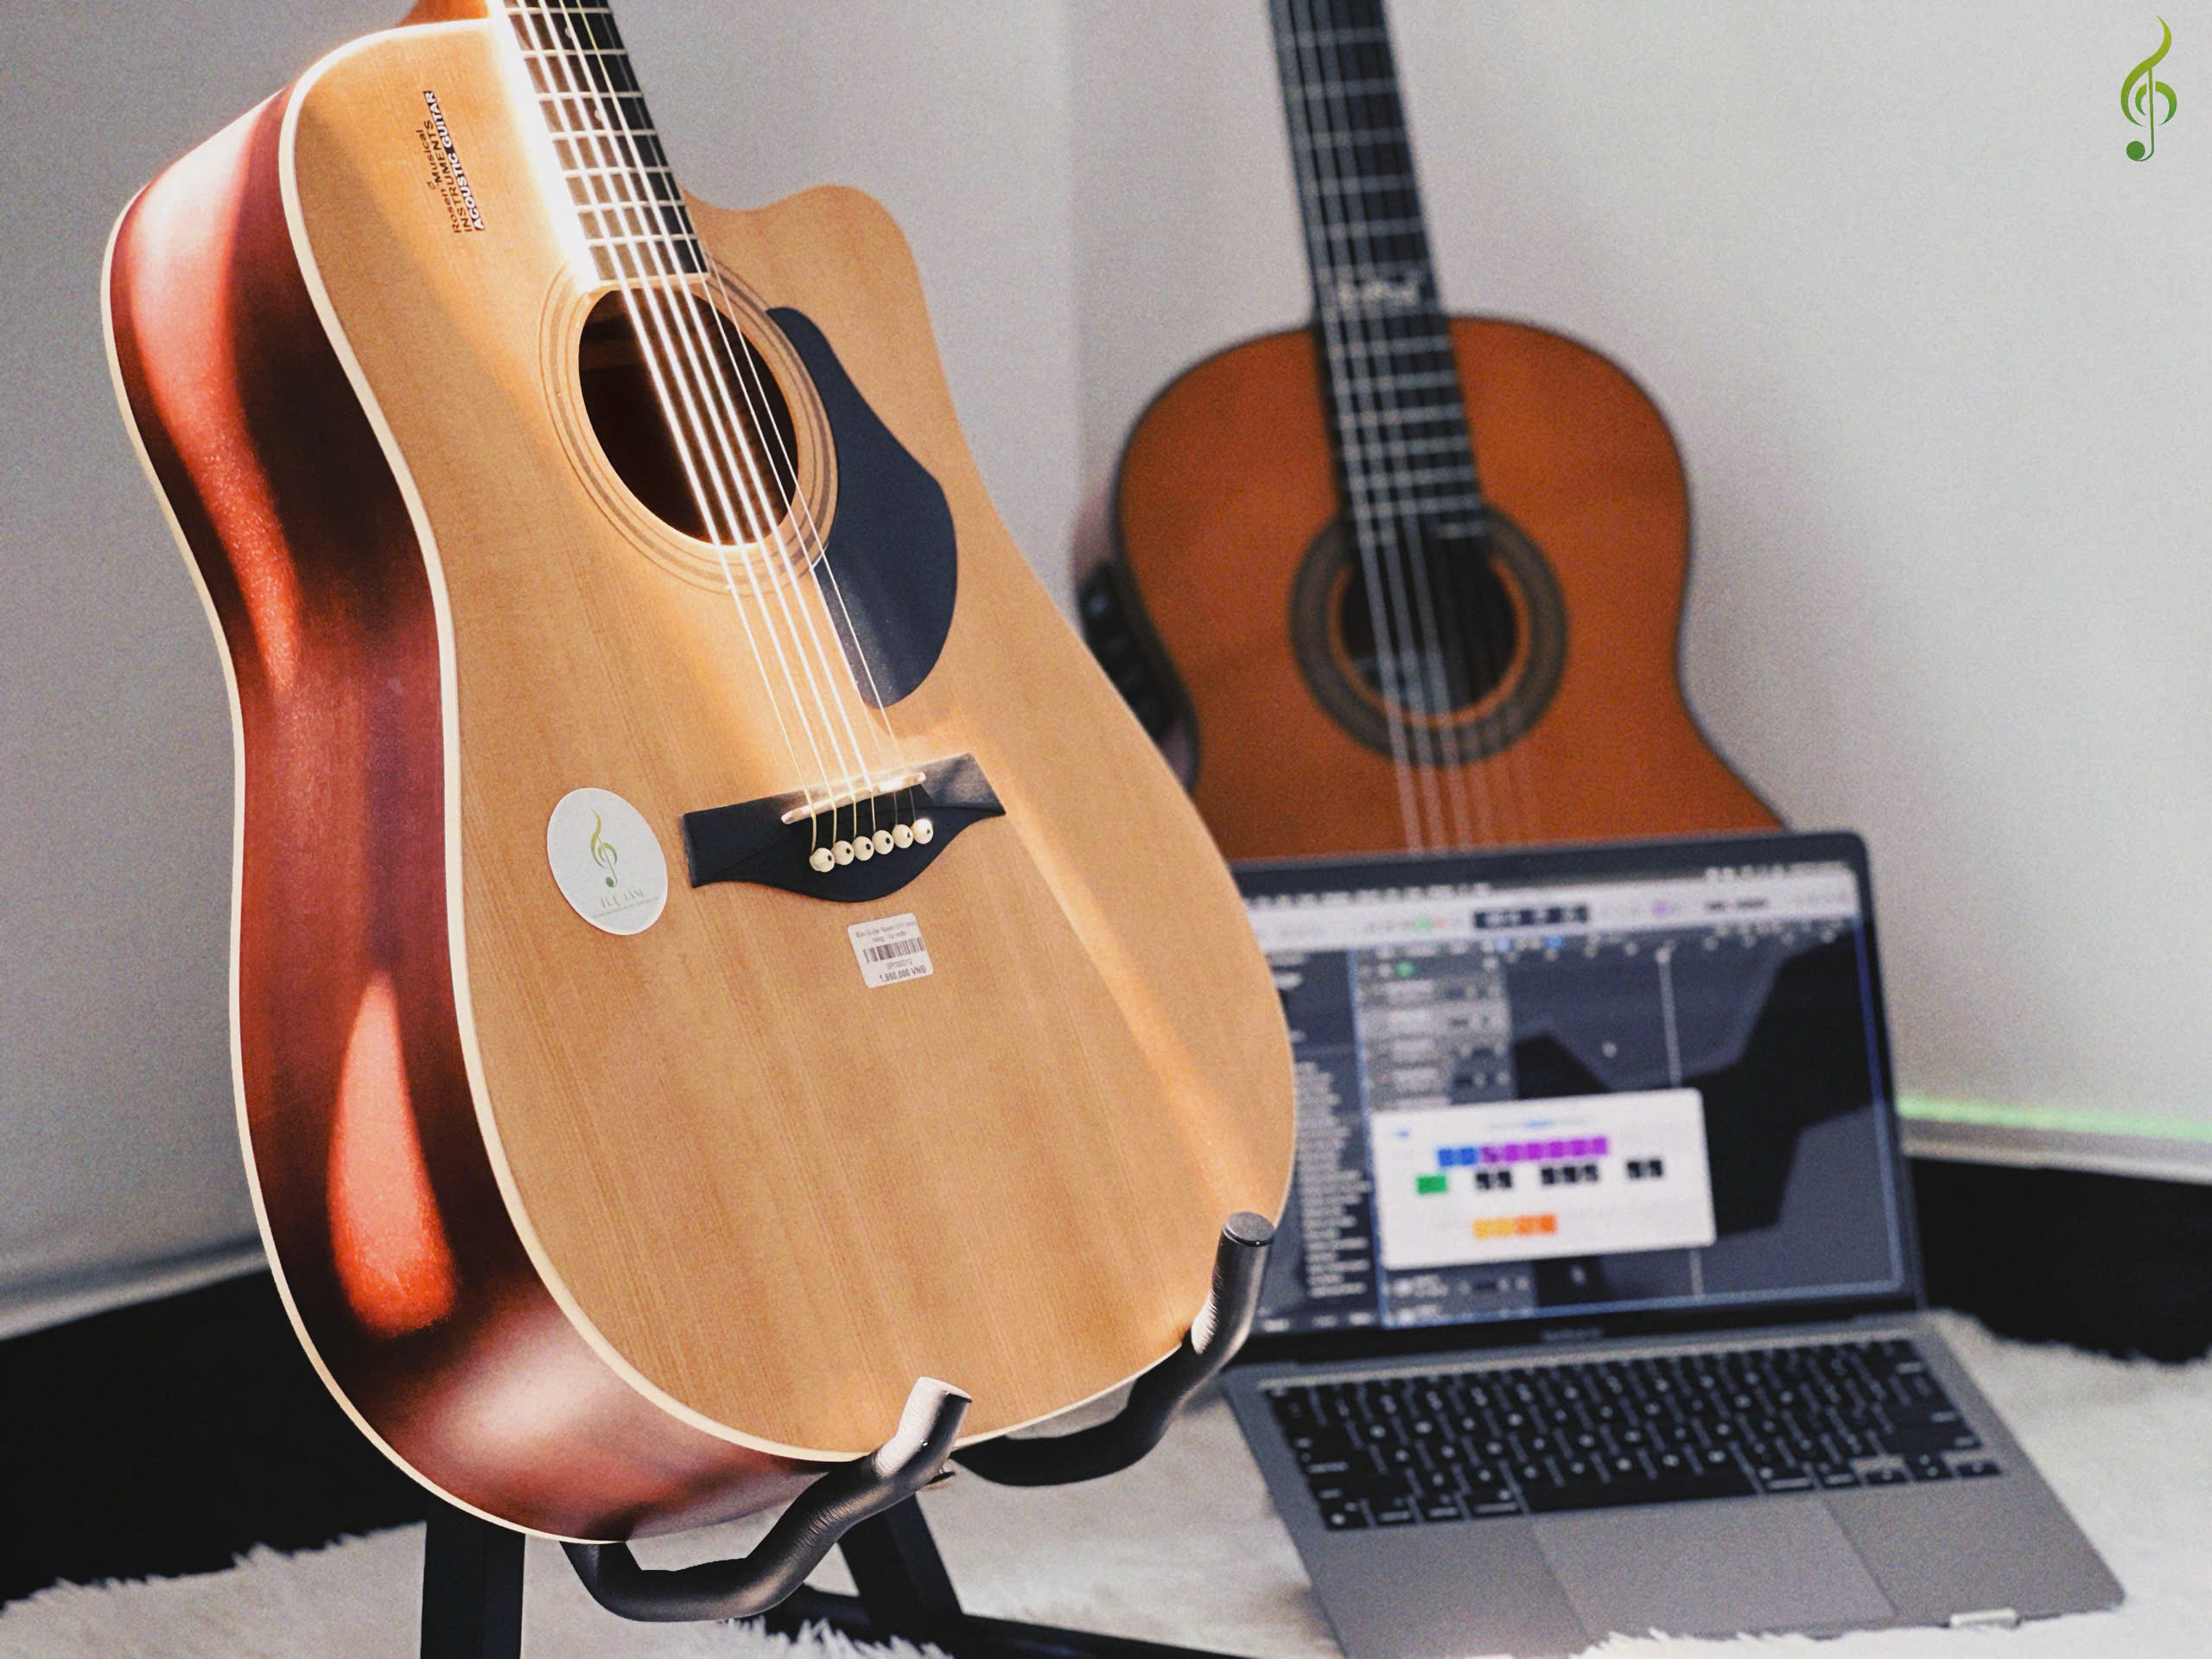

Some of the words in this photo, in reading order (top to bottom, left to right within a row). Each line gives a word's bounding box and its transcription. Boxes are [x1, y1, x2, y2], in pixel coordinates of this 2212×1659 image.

[423, 90, 453, 149] GUITAR
[416, 130, 442, 184] Musical
[423, 119, 473, 232] INSTRUMENTS
[441, 188, 462, 233] Rosen
[447, 152, 486, 231] ACOUSTIC
